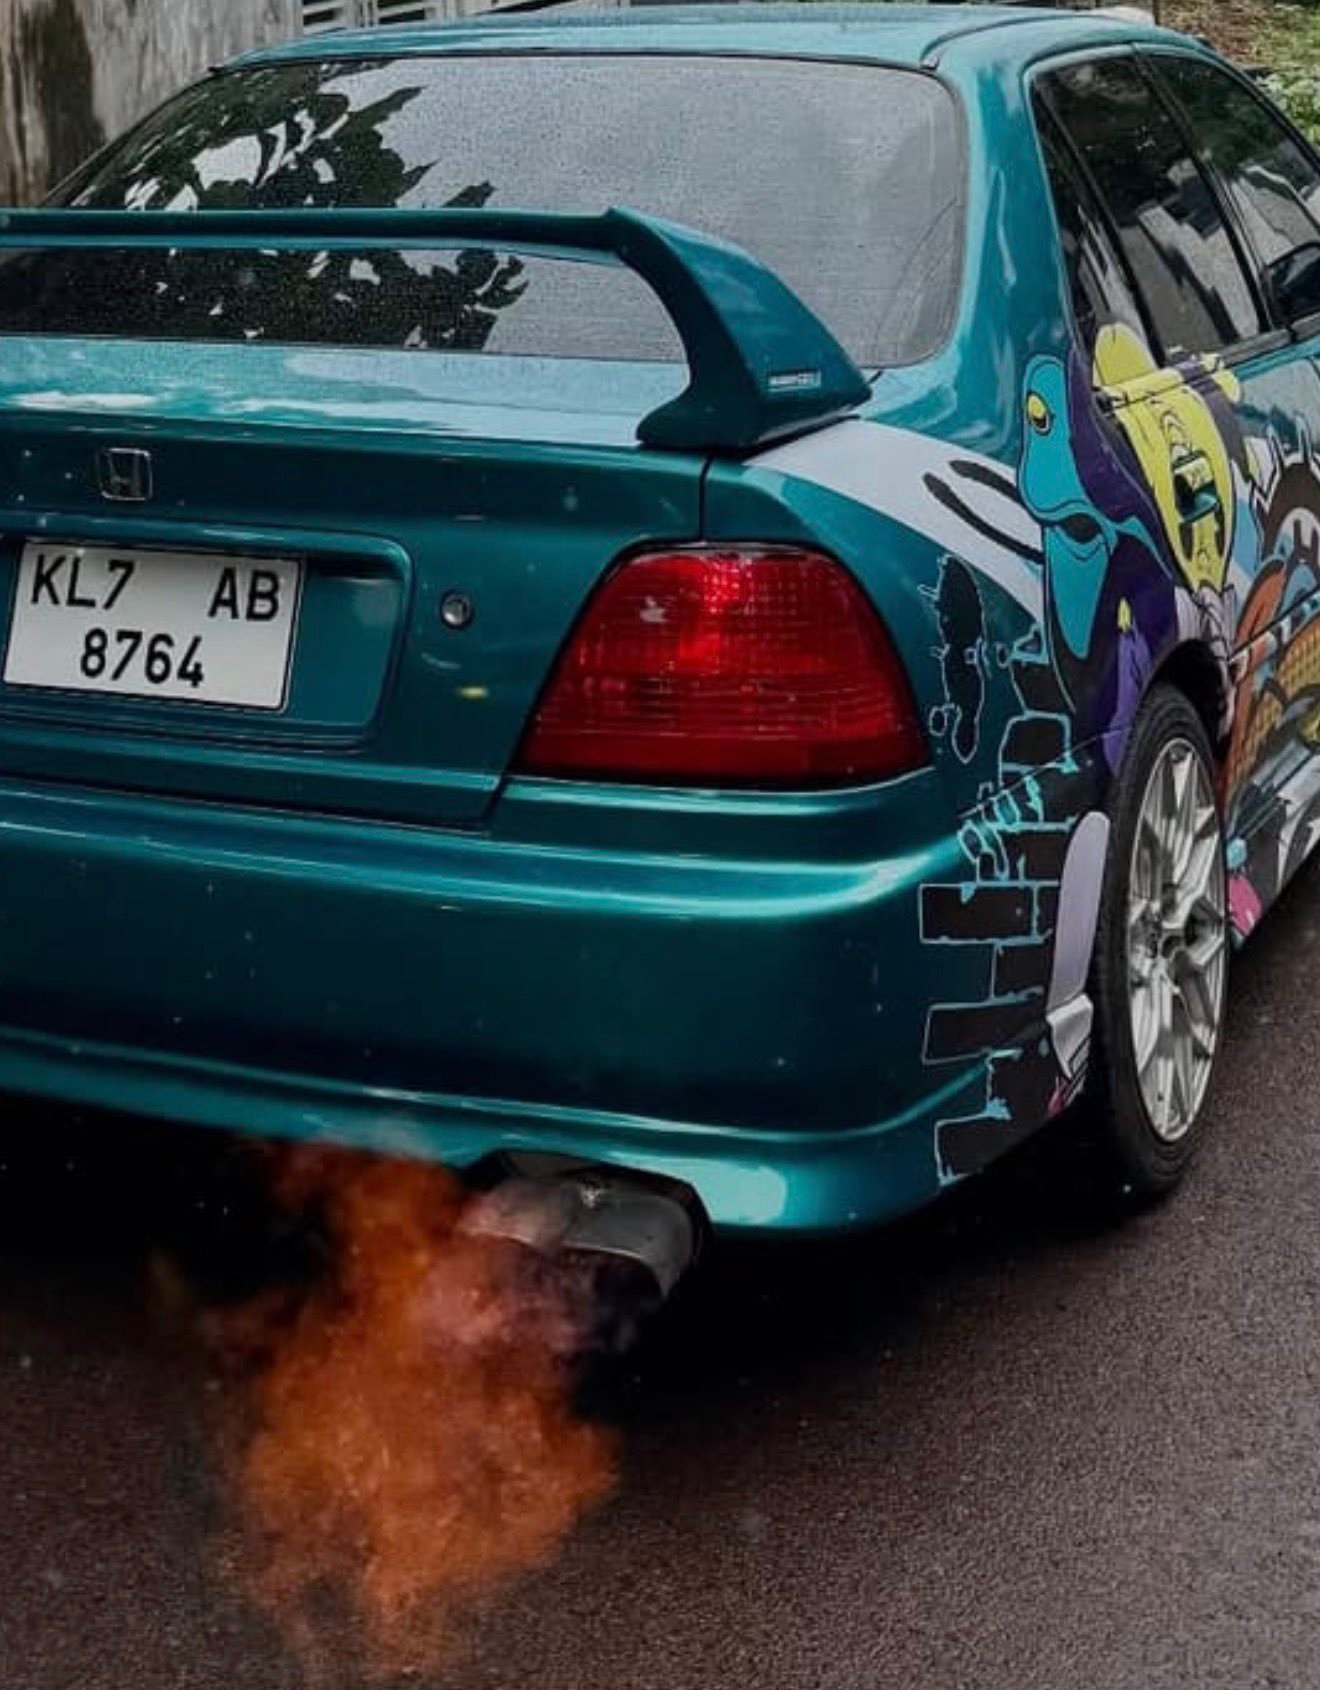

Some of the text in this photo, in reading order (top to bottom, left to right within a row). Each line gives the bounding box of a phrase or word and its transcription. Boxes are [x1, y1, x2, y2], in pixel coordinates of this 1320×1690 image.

[31, 554, 281, 622] KL7 AB
[80, 628, 204, 688] 8764
